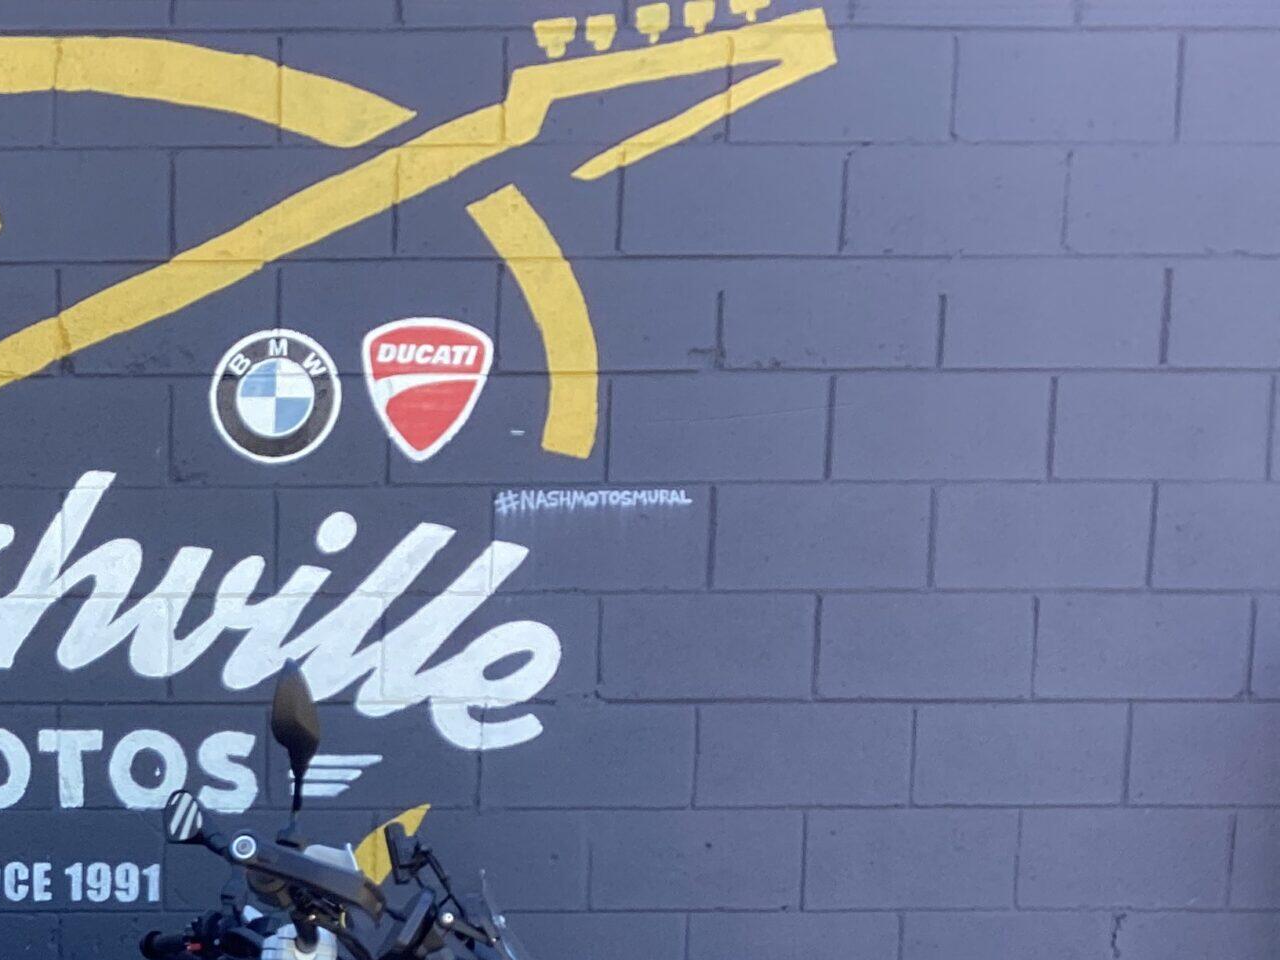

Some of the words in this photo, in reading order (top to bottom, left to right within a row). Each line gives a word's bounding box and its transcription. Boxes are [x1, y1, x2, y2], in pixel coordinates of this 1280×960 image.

[228, 338, 326, 377] BMW
[375, 342, 479, 366] DUCATI
[494, 489, 692, 514] #NASHMOTOSMURAL
[64, 862, 161, 902] 1991
